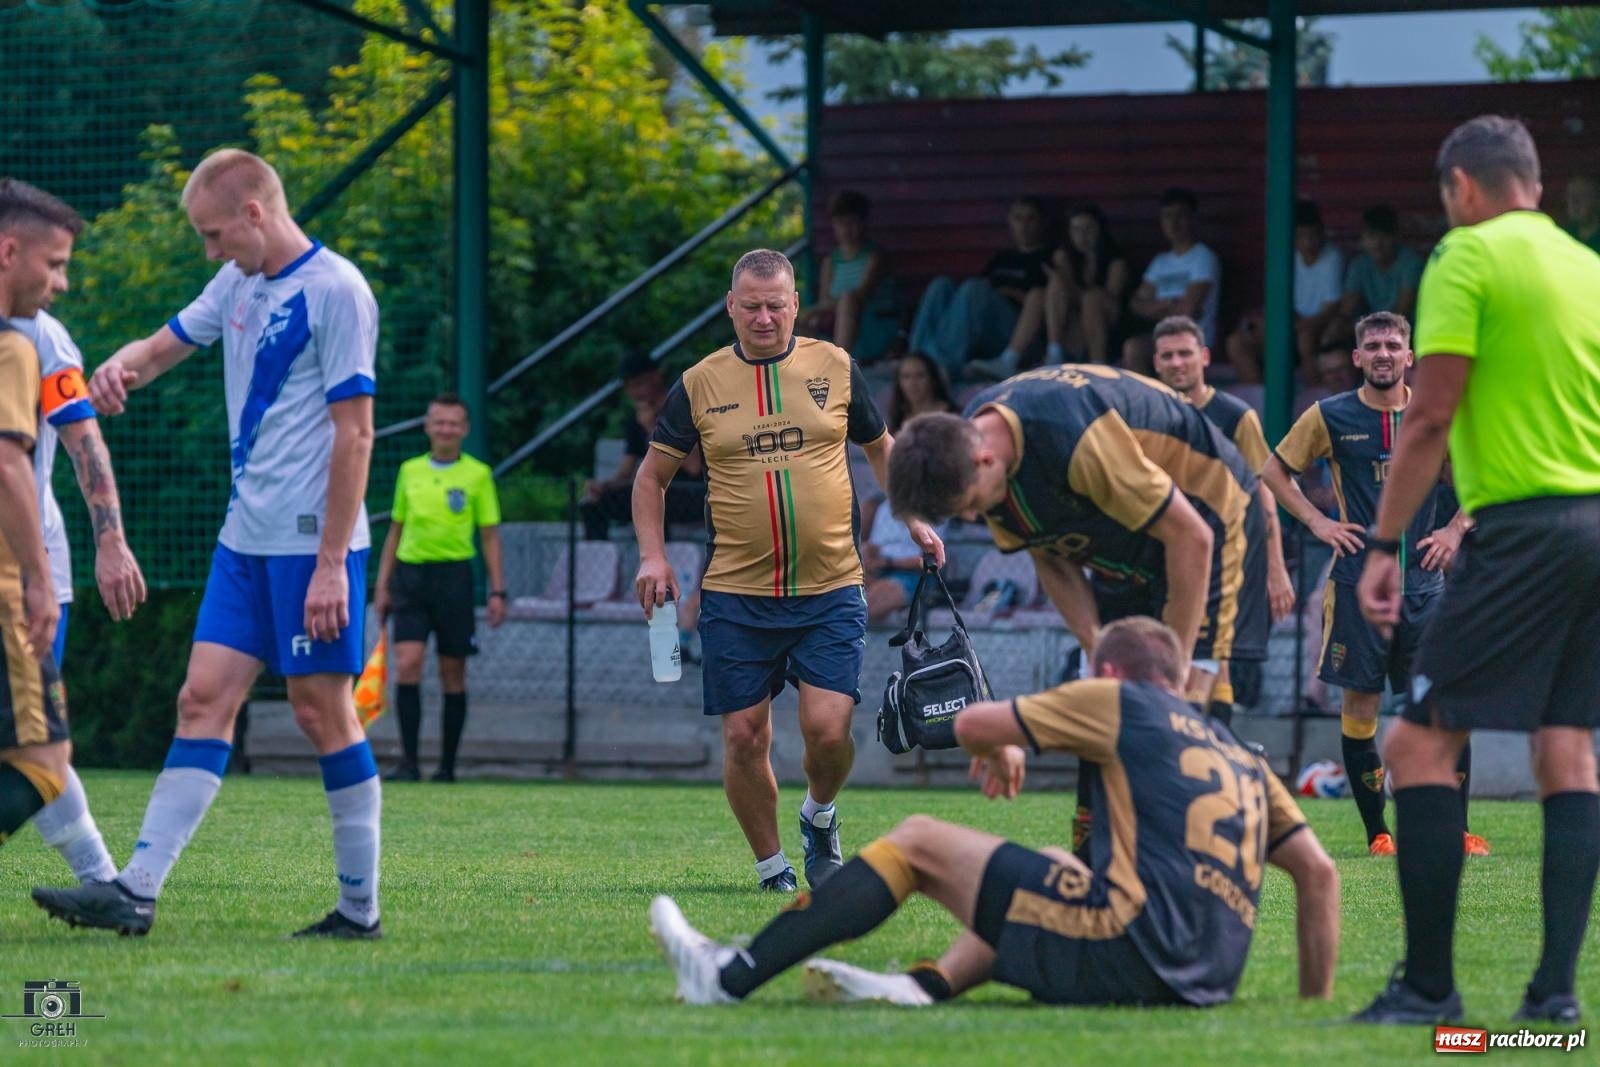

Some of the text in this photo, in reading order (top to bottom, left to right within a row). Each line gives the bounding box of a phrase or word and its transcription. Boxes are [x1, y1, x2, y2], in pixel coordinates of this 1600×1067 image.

[56, 373, 77, 399] C
[742, 427, 803, 457] 100
[761, 455, 790, 464] LECIE
[923, 696, 967, 717] SELECT
